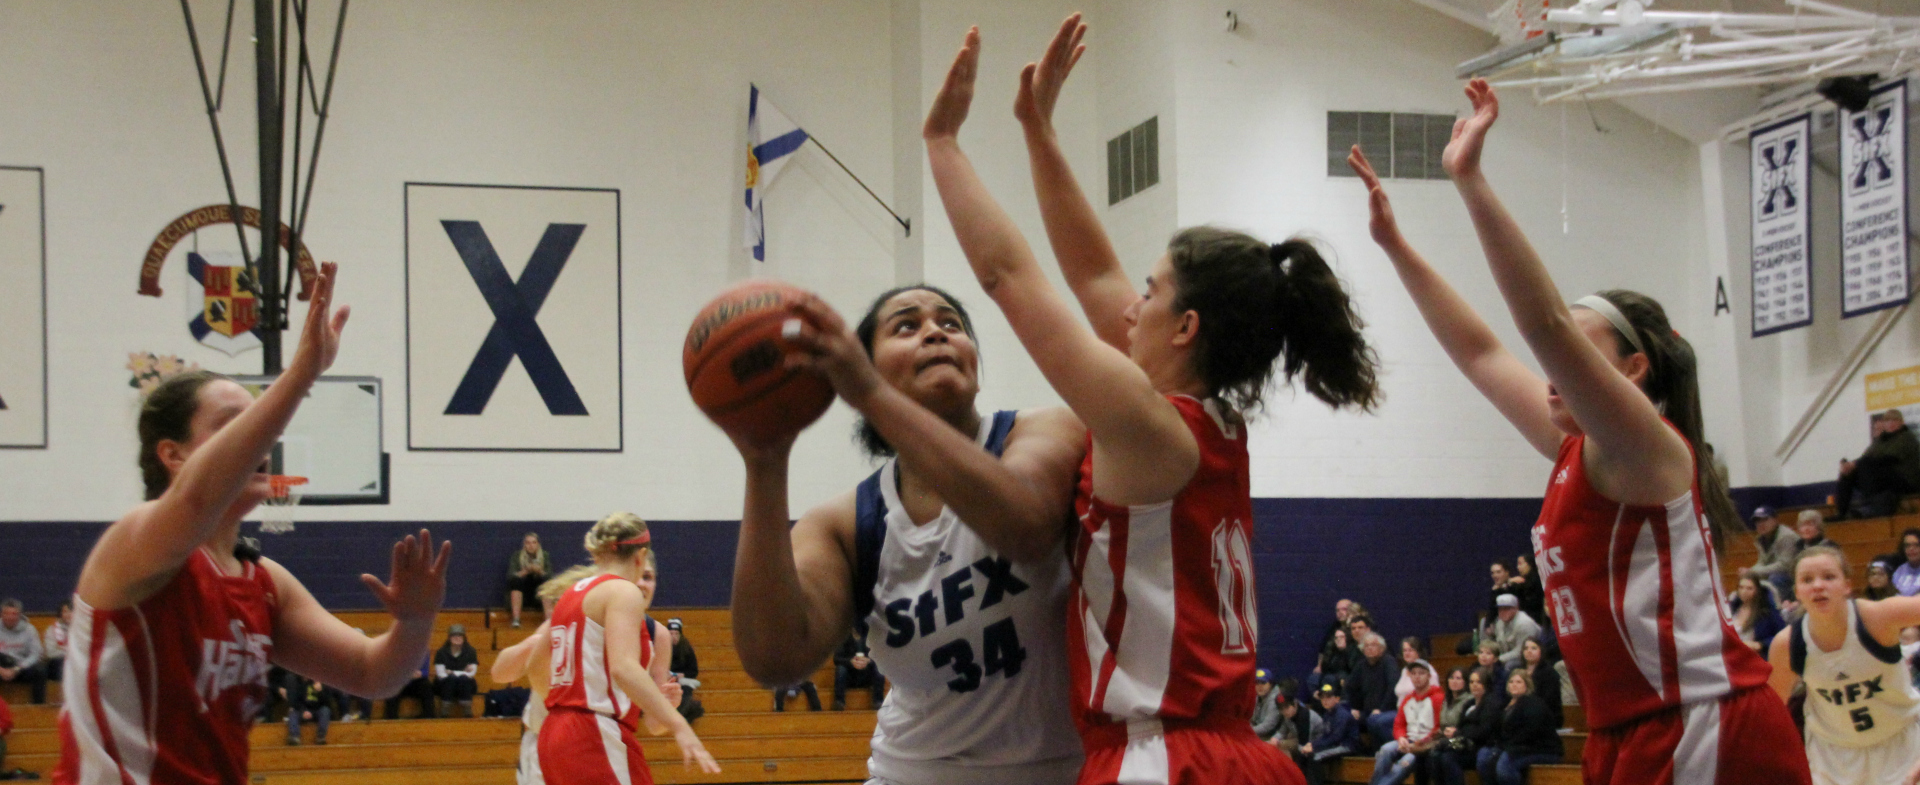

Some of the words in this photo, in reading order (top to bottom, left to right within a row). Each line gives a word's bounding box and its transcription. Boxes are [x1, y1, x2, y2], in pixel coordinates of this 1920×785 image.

[1845, 208, 1898, 233] CONFERENCE
[1845, 223, 1899, 250] CHAMPIONS
[1754, 249, 1802, 272] CHAMPIONS
[1755, 234, 1802, 256] CONFERENCE
[1714, 275, 1730, 317] A
[439, 219, 590, 416] X
[885, 555, 1031, 648] StFX
[1211, 517, 1258, 655] 11
[930, 616, 1027, 693] 34
[1849, 706, 1875, 732] 5
